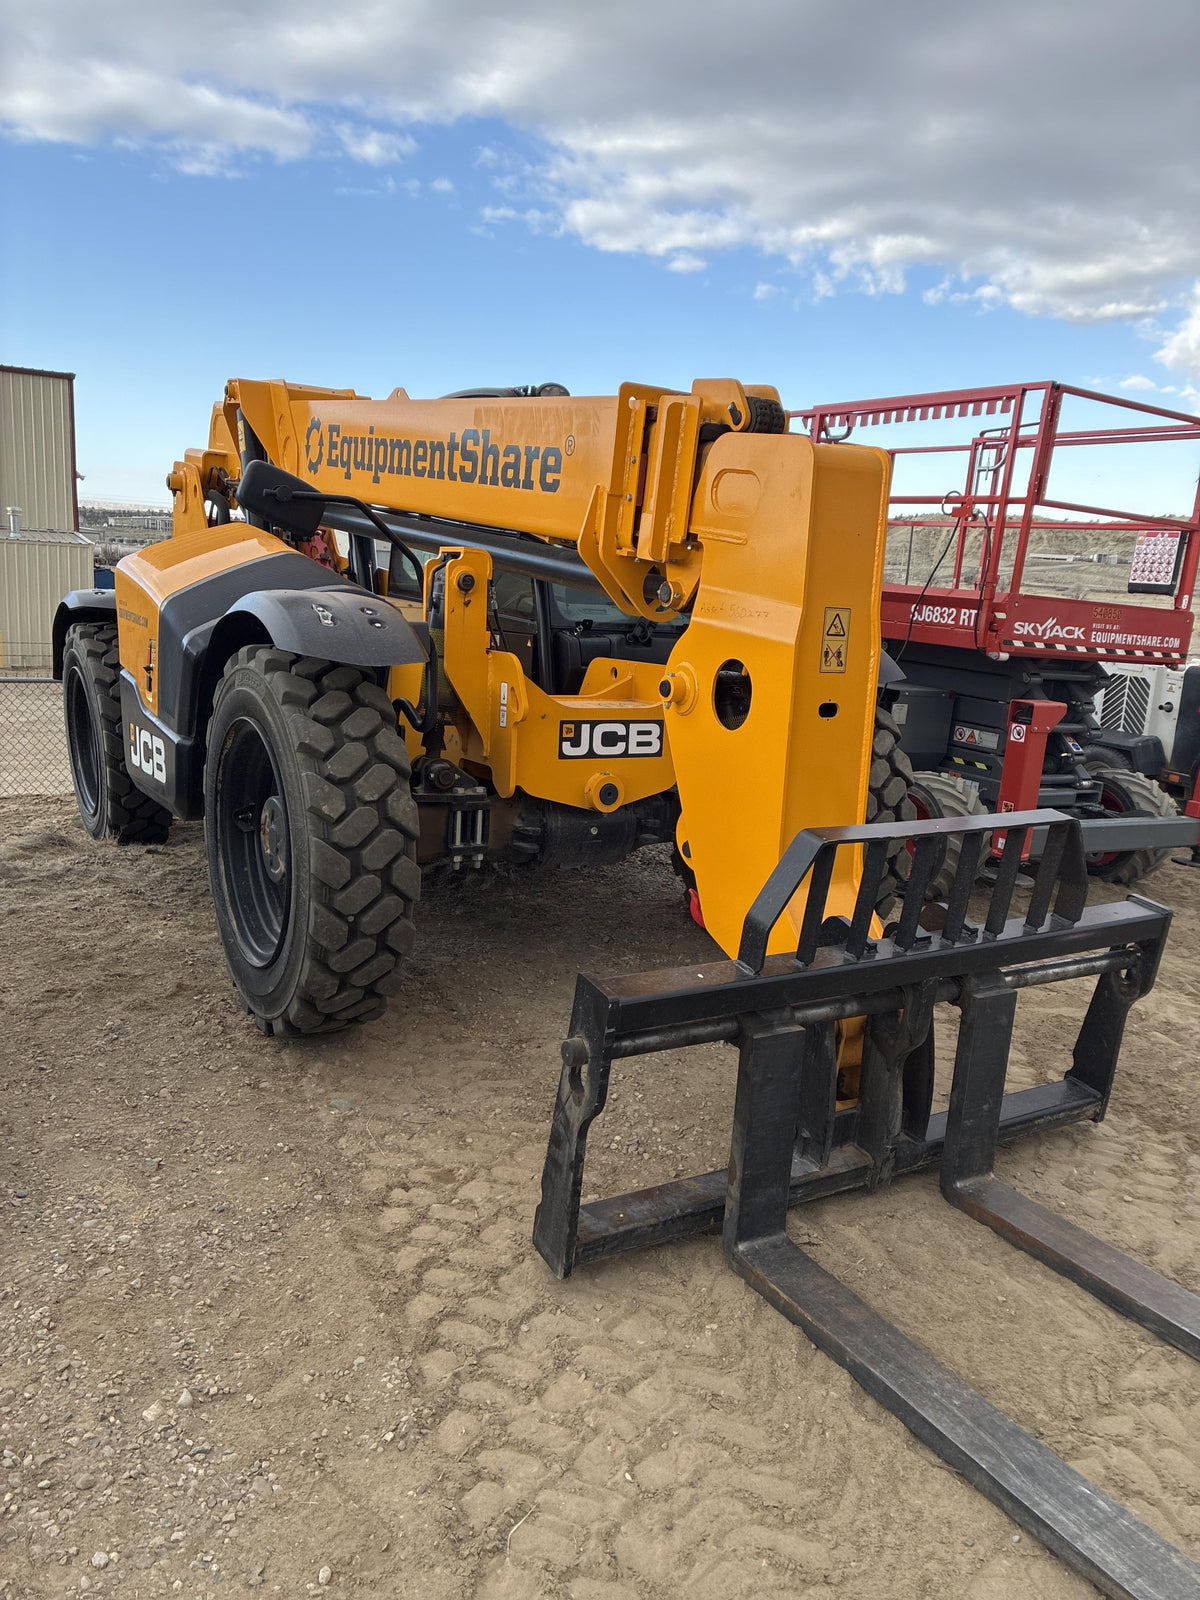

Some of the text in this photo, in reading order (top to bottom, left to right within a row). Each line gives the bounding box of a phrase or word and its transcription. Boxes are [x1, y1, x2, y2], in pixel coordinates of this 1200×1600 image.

[910, 604, 978, 627] SJ6832 RT
[1013, 616, 1087, 640] SKYJACK
[1091, 631, 1181, 648] EQUIPMENTSHARE.COM
[561, 722, 662, 757] JCB
[130, 725, 167, 784] JCB
